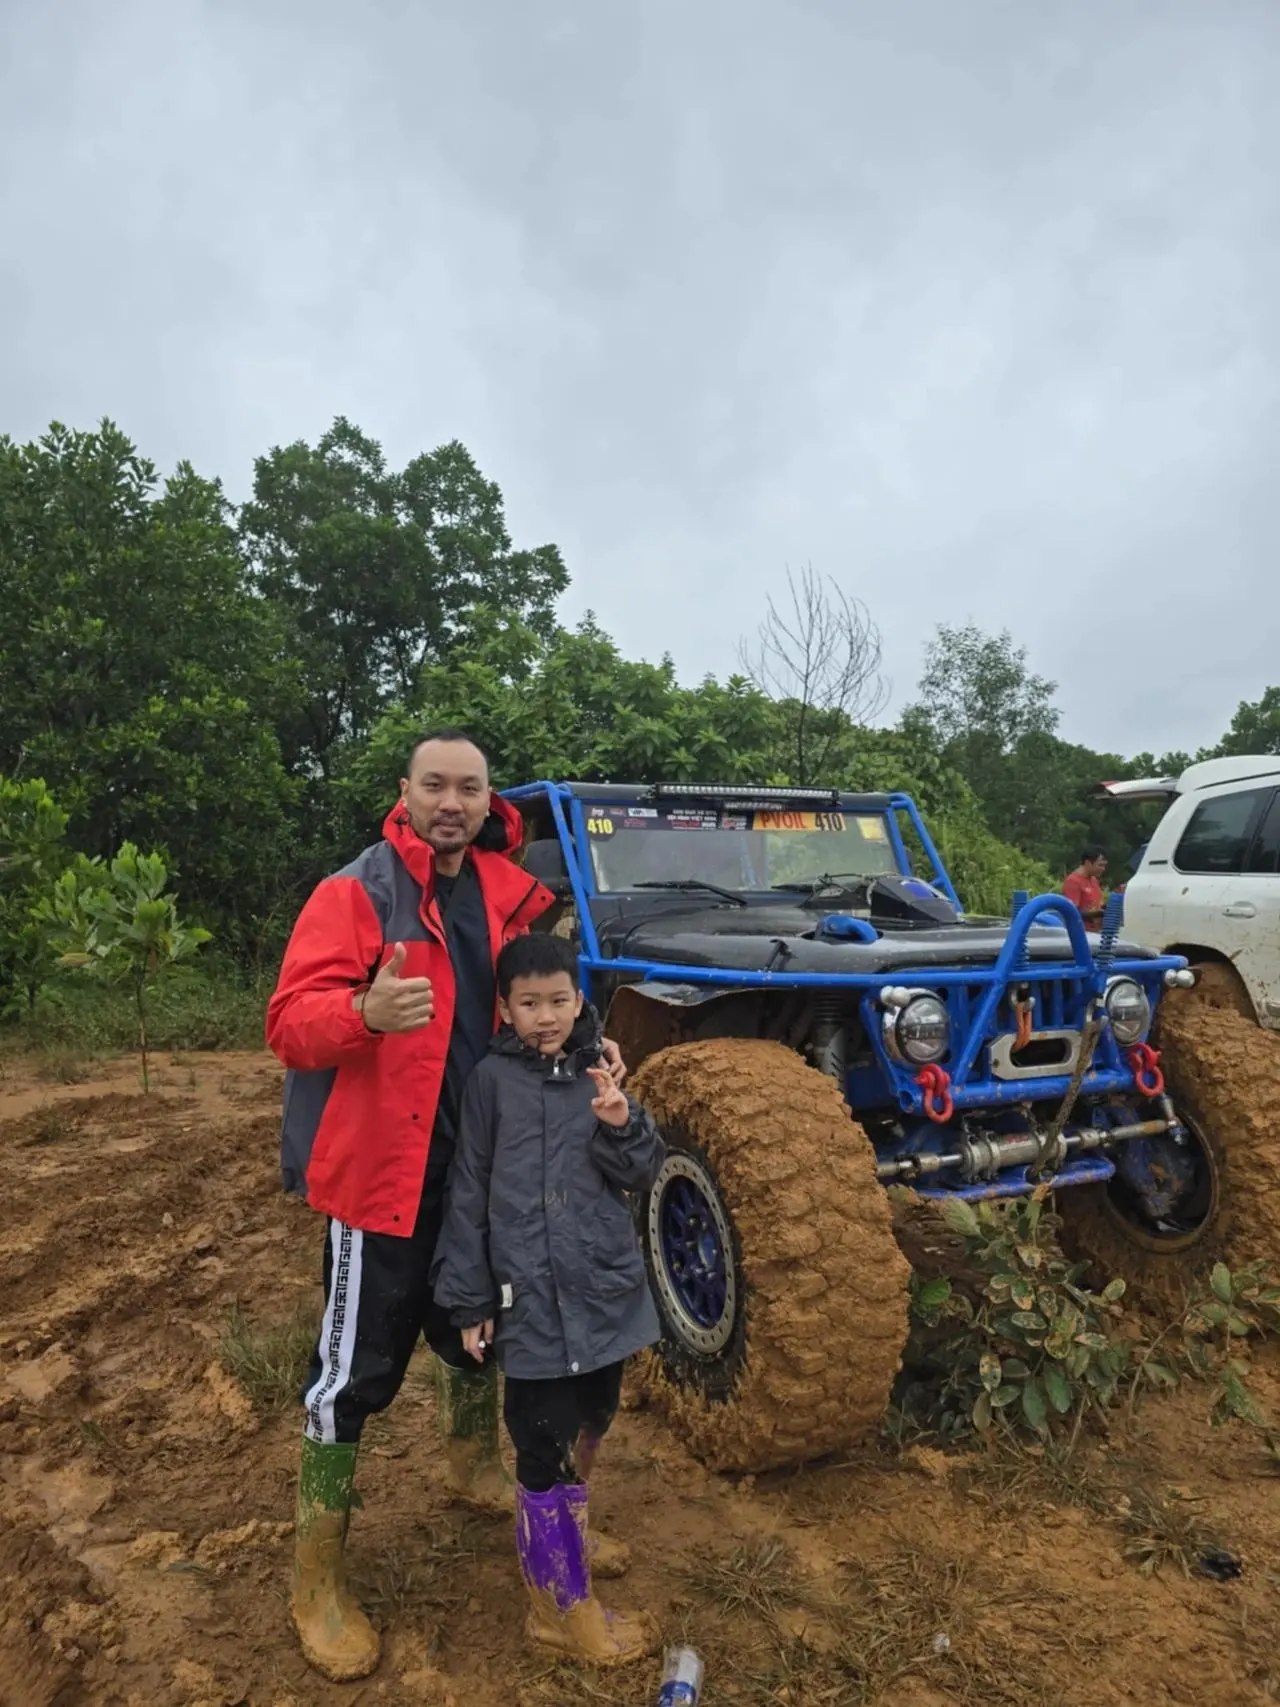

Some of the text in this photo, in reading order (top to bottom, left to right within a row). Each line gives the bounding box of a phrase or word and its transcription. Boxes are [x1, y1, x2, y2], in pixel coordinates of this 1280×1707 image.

[587, 818, 613, 835] 410
[759, 811, 808, 829] PVOIL
[815, 812, 843, 832] 410
